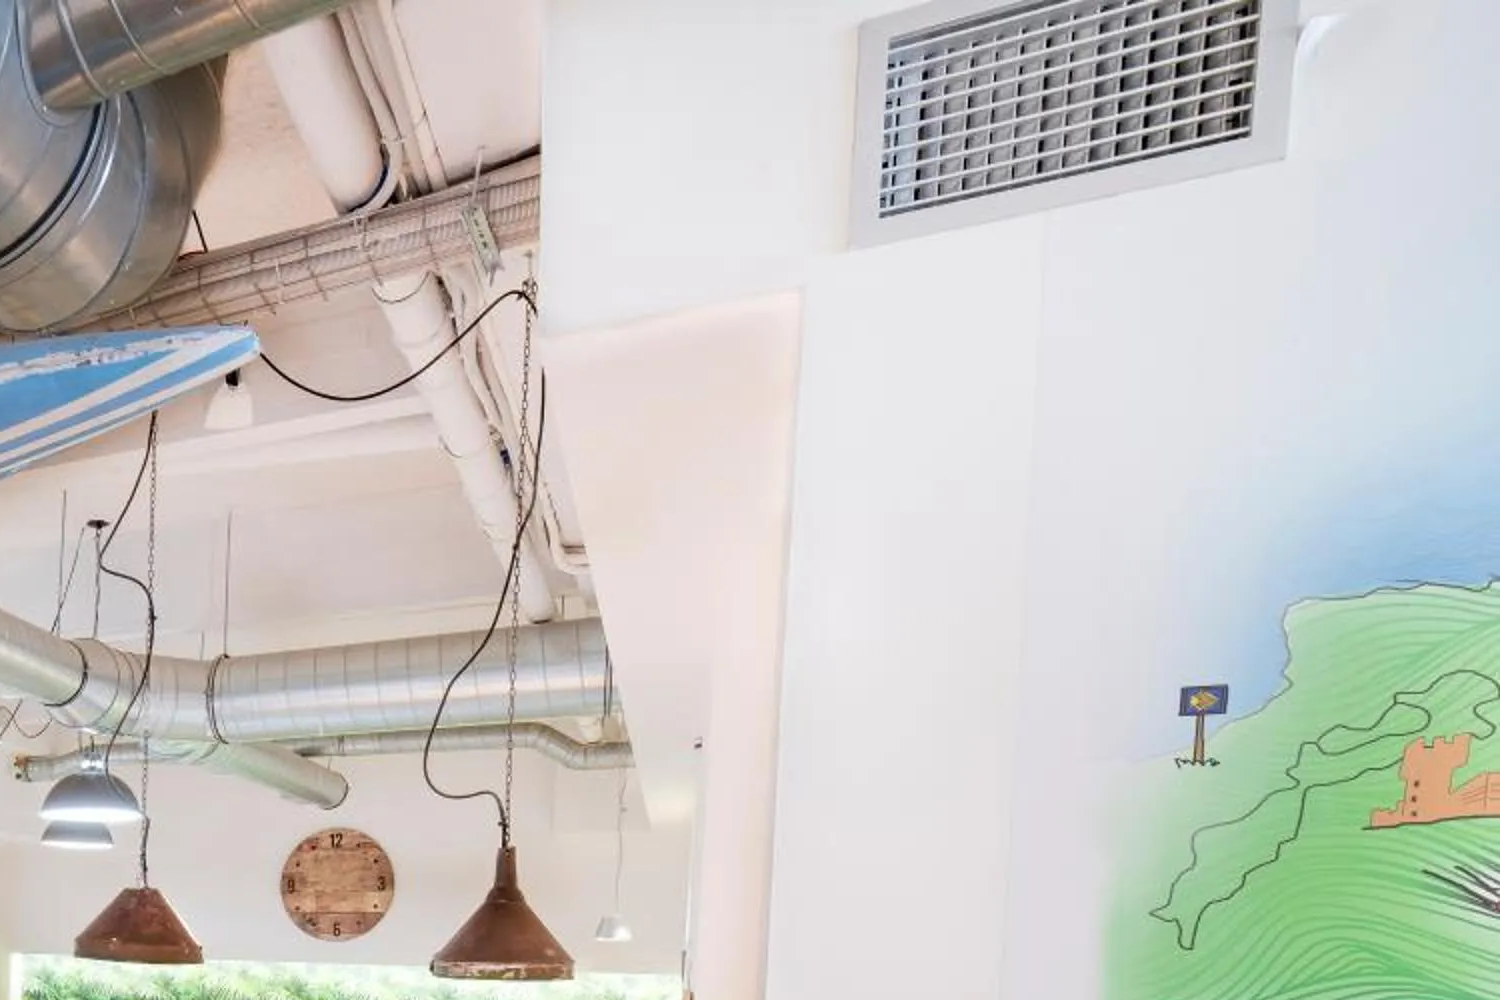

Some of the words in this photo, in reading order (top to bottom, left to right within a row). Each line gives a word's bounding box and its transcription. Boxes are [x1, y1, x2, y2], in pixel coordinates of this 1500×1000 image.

[329, 833, 343, 849] 12
[287, 879, 296, 894] 9
[377, 876, 386, 891] 3
[332, 922, 341, 937] 6
